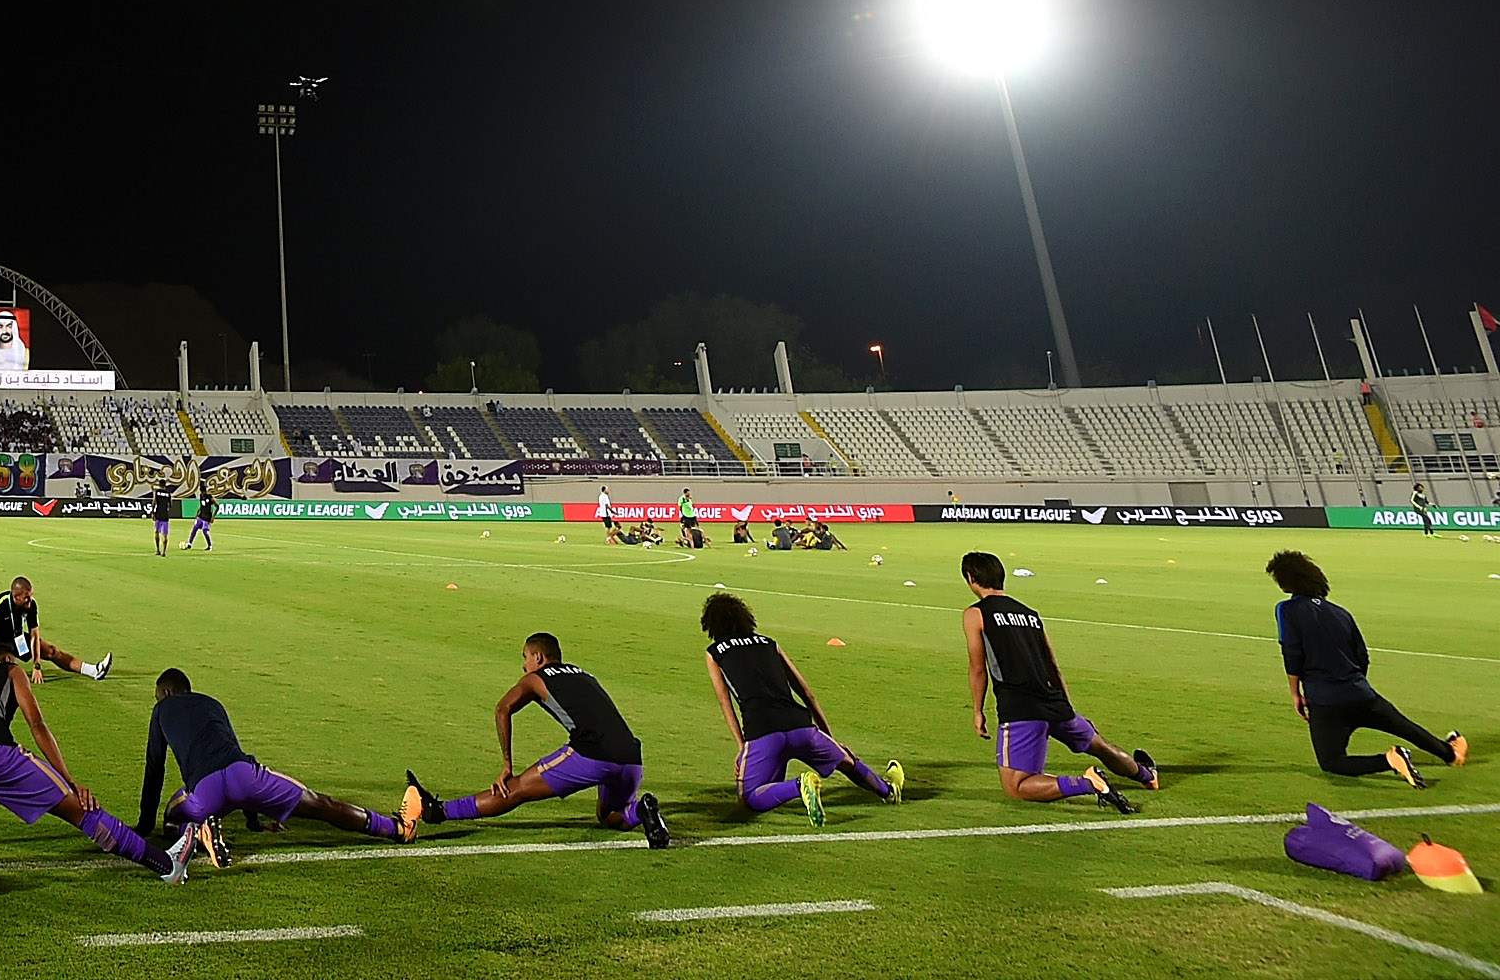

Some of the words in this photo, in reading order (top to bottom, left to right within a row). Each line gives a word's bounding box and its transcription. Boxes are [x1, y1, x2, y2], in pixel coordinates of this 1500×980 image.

[5, 374, 19, 385] بن
[23, 373, 60, 386] خليفة
[63, 374, 103, 385] استاد
[63, 500, 101, 513] العربي
[103, 501, 142, 514] الخليج
[217, 503, 270, 516] ARABIAN
[273, 504, 304, 516] GULF
[397, 503, 445, 519] العربي
[448, 503, 498, 520] الخليج
[501, 504, 532, 520] دوري
[647, 507, 676, 518] GULF
[760, 504, 805, 521] العربي
[807, 504, 854, 521] الخليج
[856, 506, 885, 521] دوري
[941, 507, 989, 519] ARABIAN
[991, 508, 1021, 520] GULF
[1116, 506, 1172, 524] العربي
[1175, 507, 1239, 525] الخليج
[1240, 509, 1283, 526] دوري
[1453, 511, 1500, 526] GULF
[993, 612, 1009, 626] AL
[1007, 612, 1028, 626] AIN
[716, 641, 730, 654] AL
